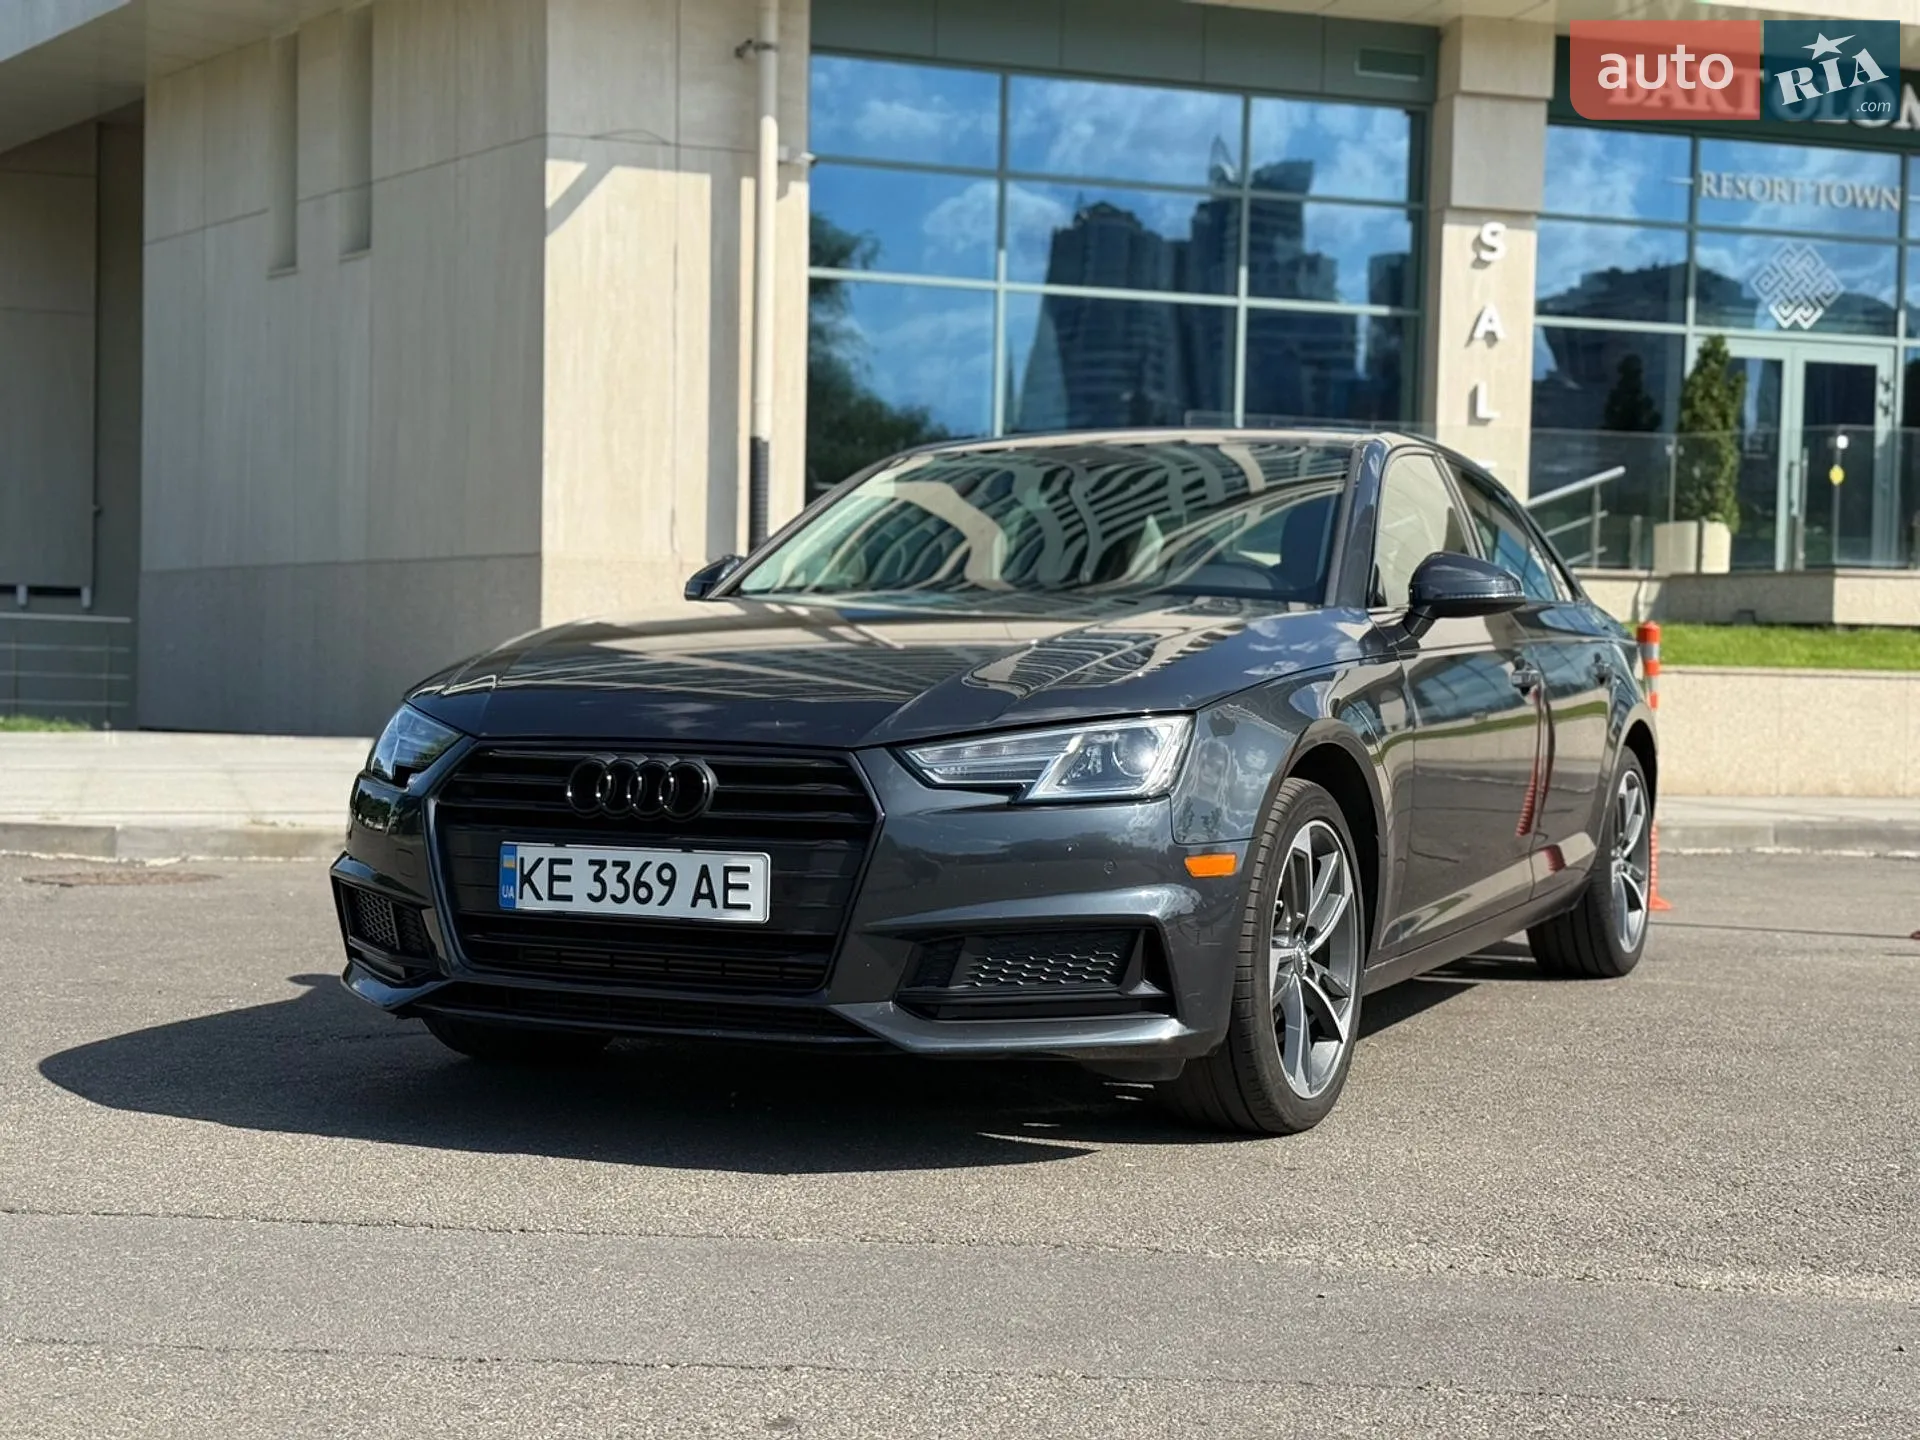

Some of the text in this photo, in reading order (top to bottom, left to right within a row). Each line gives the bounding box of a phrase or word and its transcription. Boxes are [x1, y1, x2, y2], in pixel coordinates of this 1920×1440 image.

[1701, 171, 1901, 212] RESORT TOWN
[1472, 221, 1509, 470] SAL
[502, 884, 515, 898] UA
[518, 856, 752, 910] KE 3369 AE
